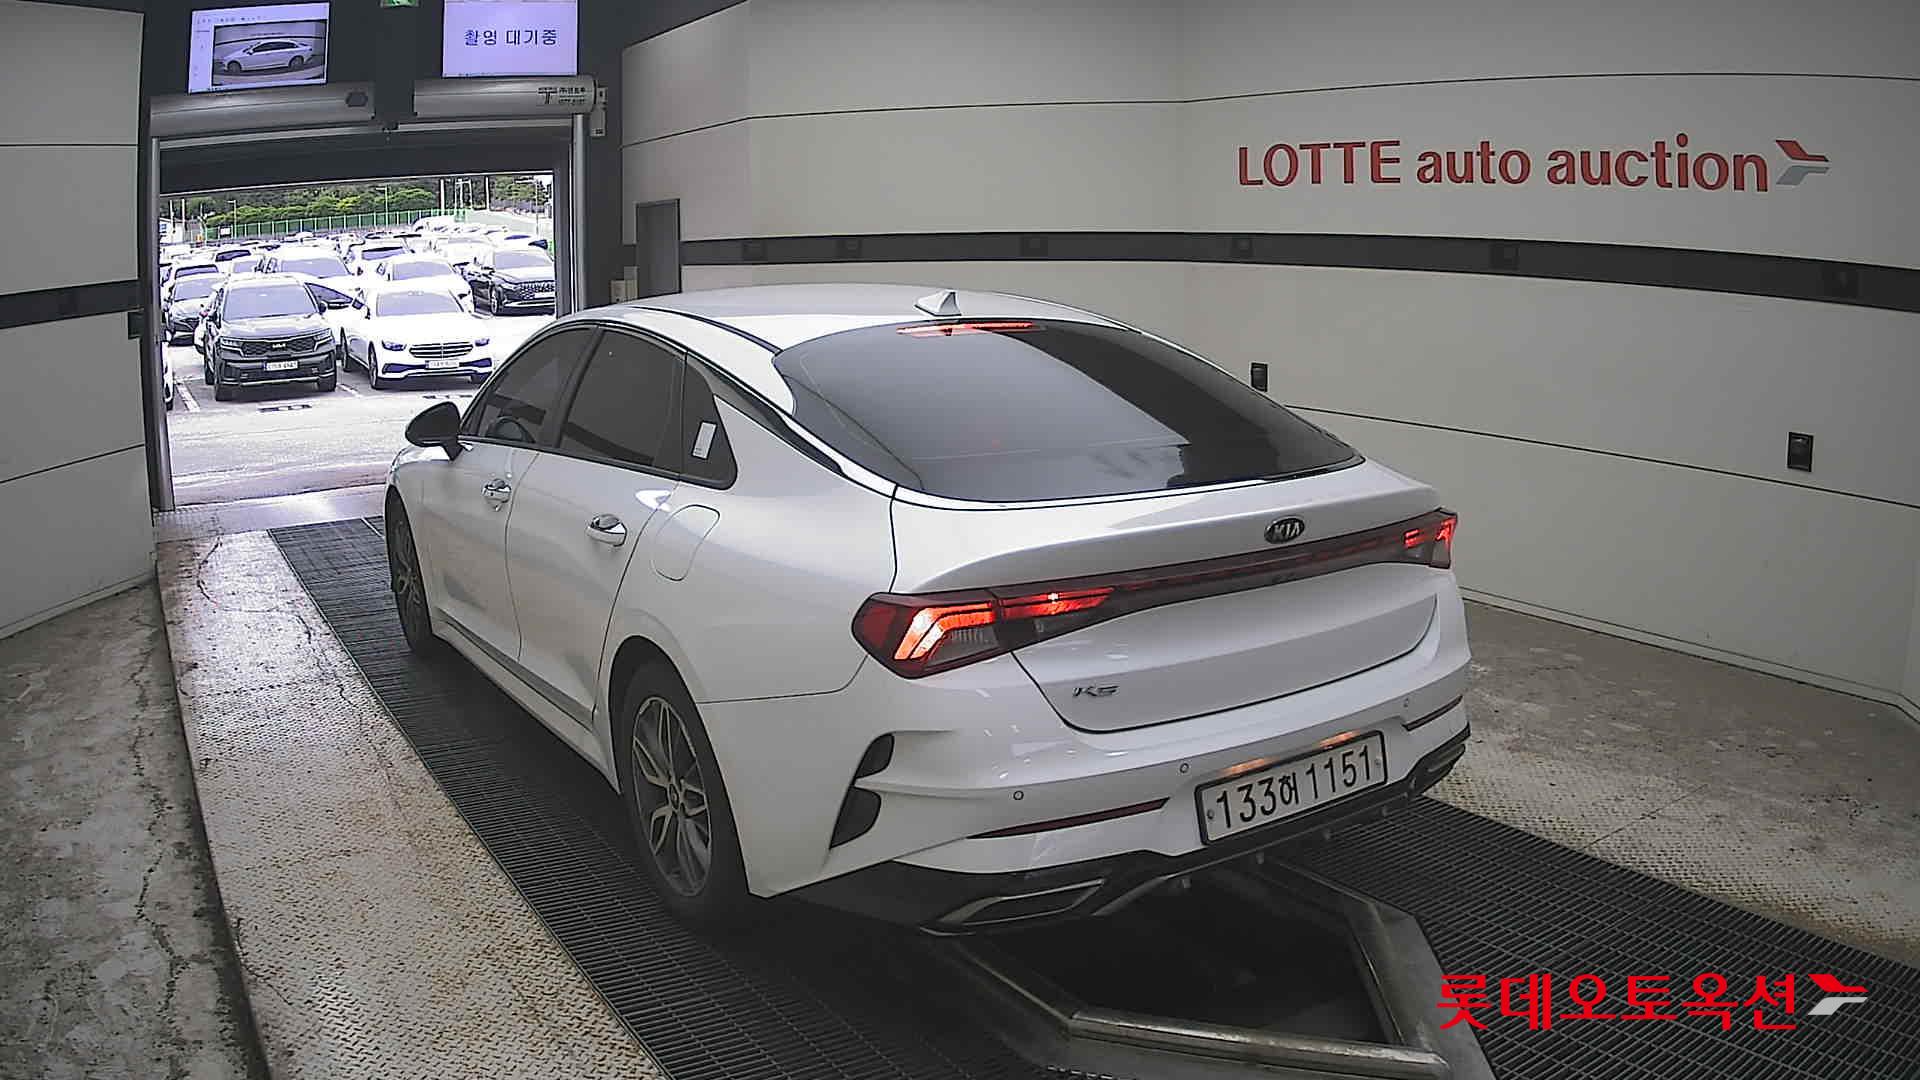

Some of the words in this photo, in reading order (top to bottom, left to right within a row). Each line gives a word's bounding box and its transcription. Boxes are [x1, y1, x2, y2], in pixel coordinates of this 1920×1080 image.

[506, 29, 558, 46] 대기중
[1237, 139, 1401, 188] LOTTE
[1416, 140, 1532, 186] auto
[1547, 132, 1770, 192] auction
[1274, 521, 1301, 538] KIA
[1215, 771, 1300, 829] 133허
[1305, 744, 1371, 800] 1151
